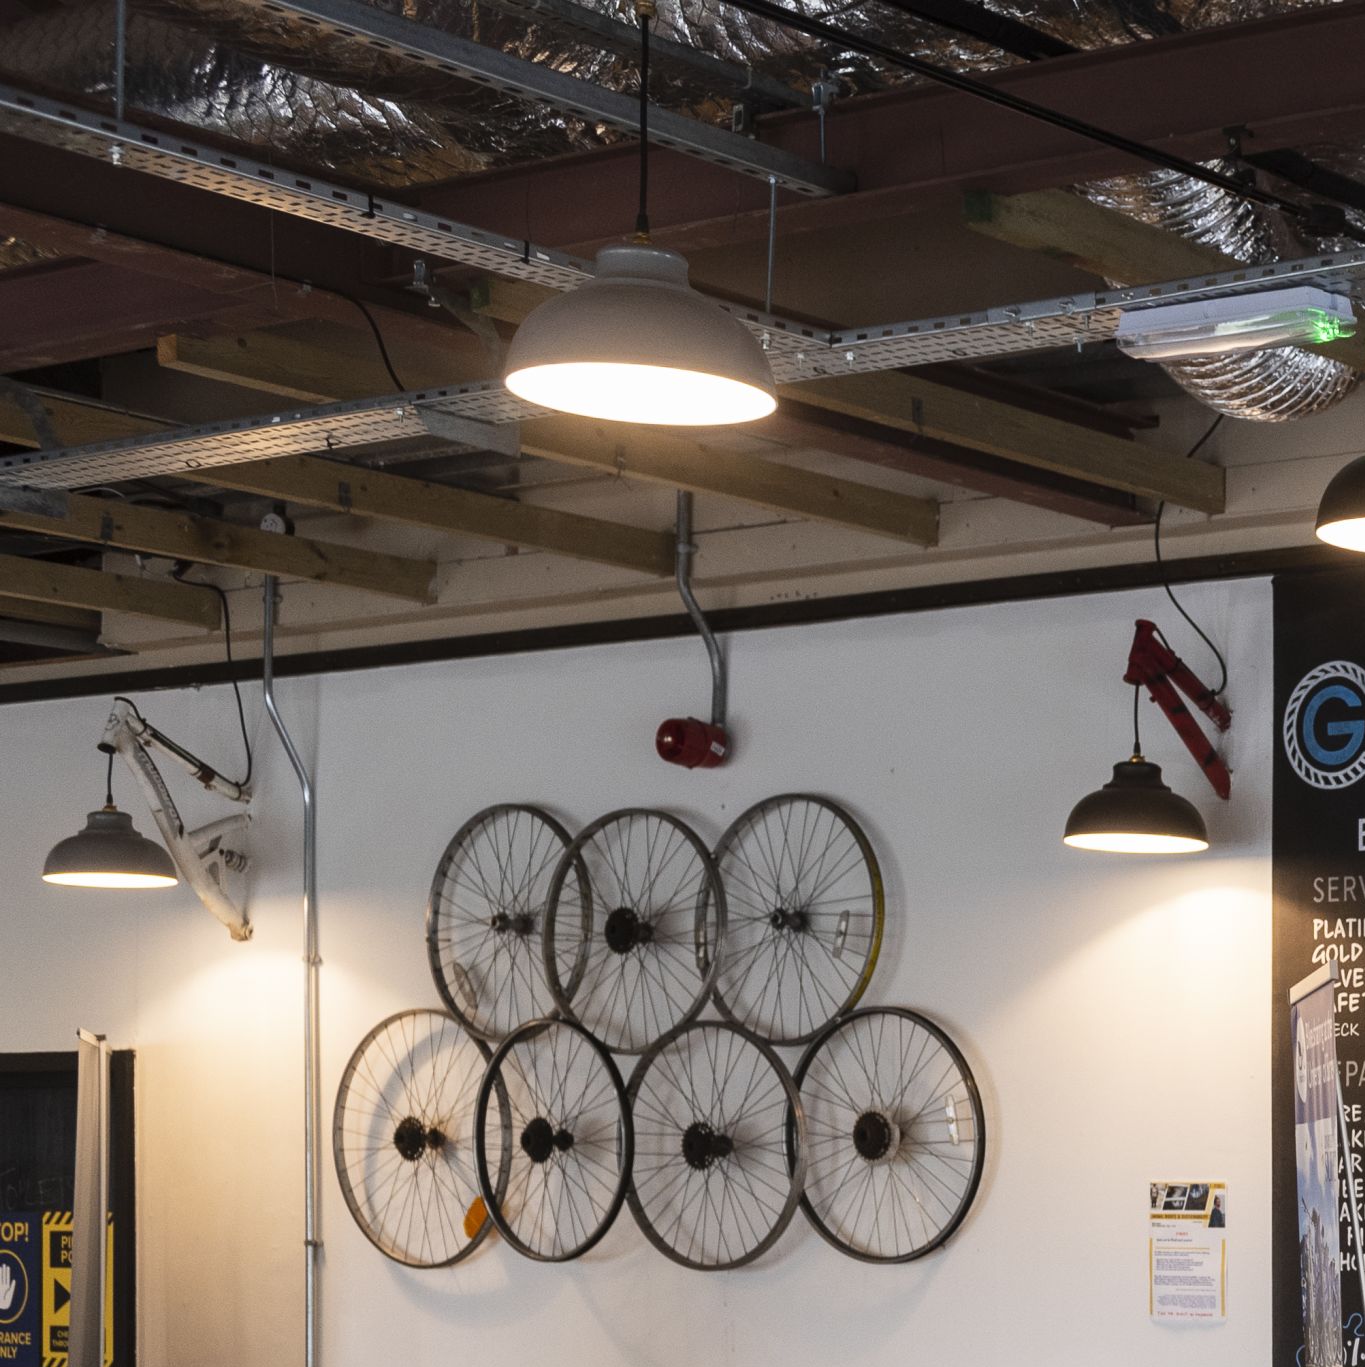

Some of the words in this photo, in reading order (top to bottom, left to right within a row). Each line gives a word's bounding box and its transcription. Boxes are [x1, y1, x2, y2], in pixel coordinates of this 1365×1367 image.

[1311, 943, 1363, 965] GOLD
[1335, 1022, 1360, 1036] ECK
[0, 1332, 31, 1345] RANCE
[0, 1347, 18, 1359] NLY
